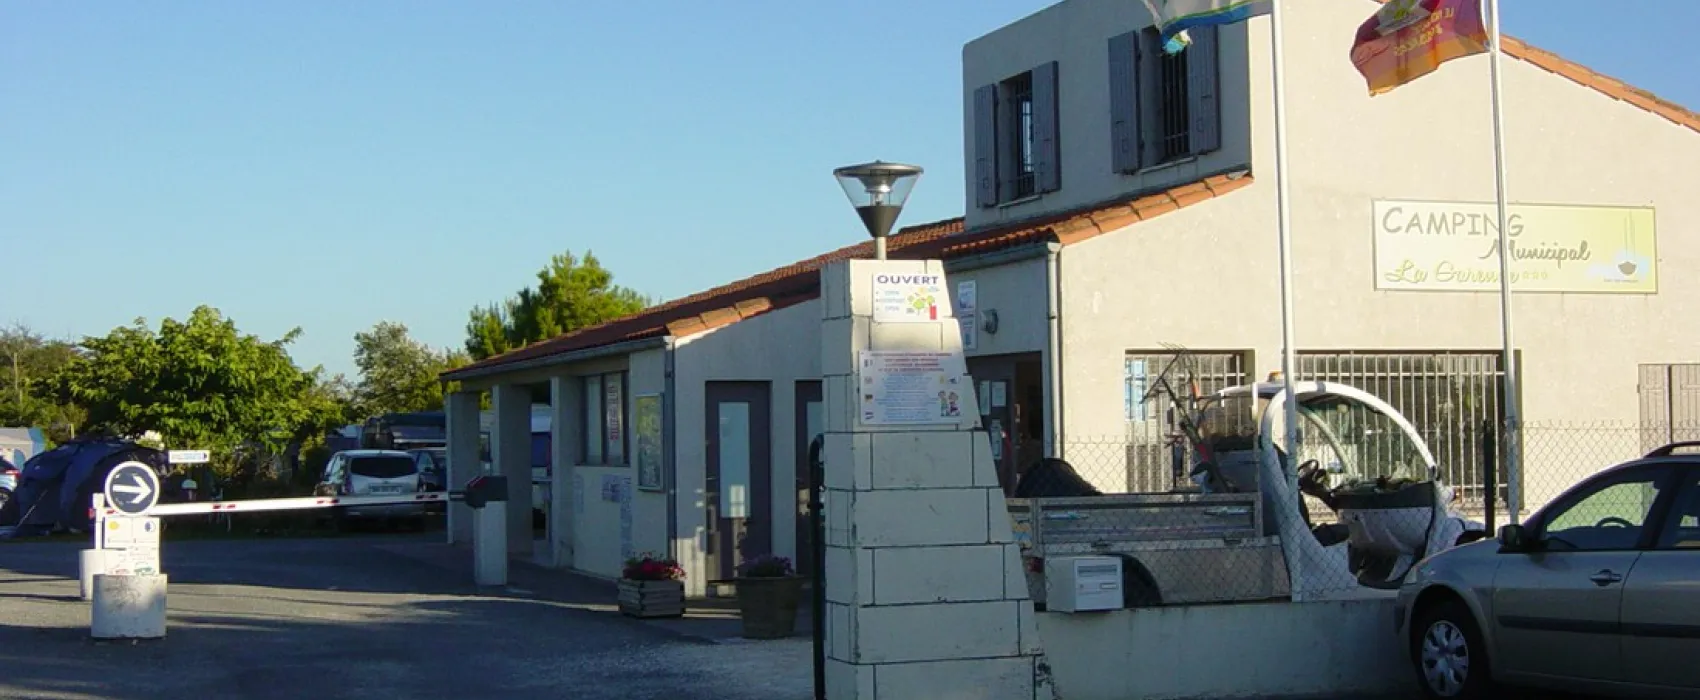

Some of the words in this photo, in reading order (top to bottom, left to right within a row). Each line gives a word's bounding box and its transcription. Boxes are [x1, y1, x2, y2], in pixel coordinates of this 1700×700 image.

[1381, 207, 1524, 237] CAMPING
[1478, 238, 1591, 269] Municipal
[877, 275, 939, 285] OUVERT
[1384, 259, 1428, 283] La
[1434, 260, 1520, 284] Garene
